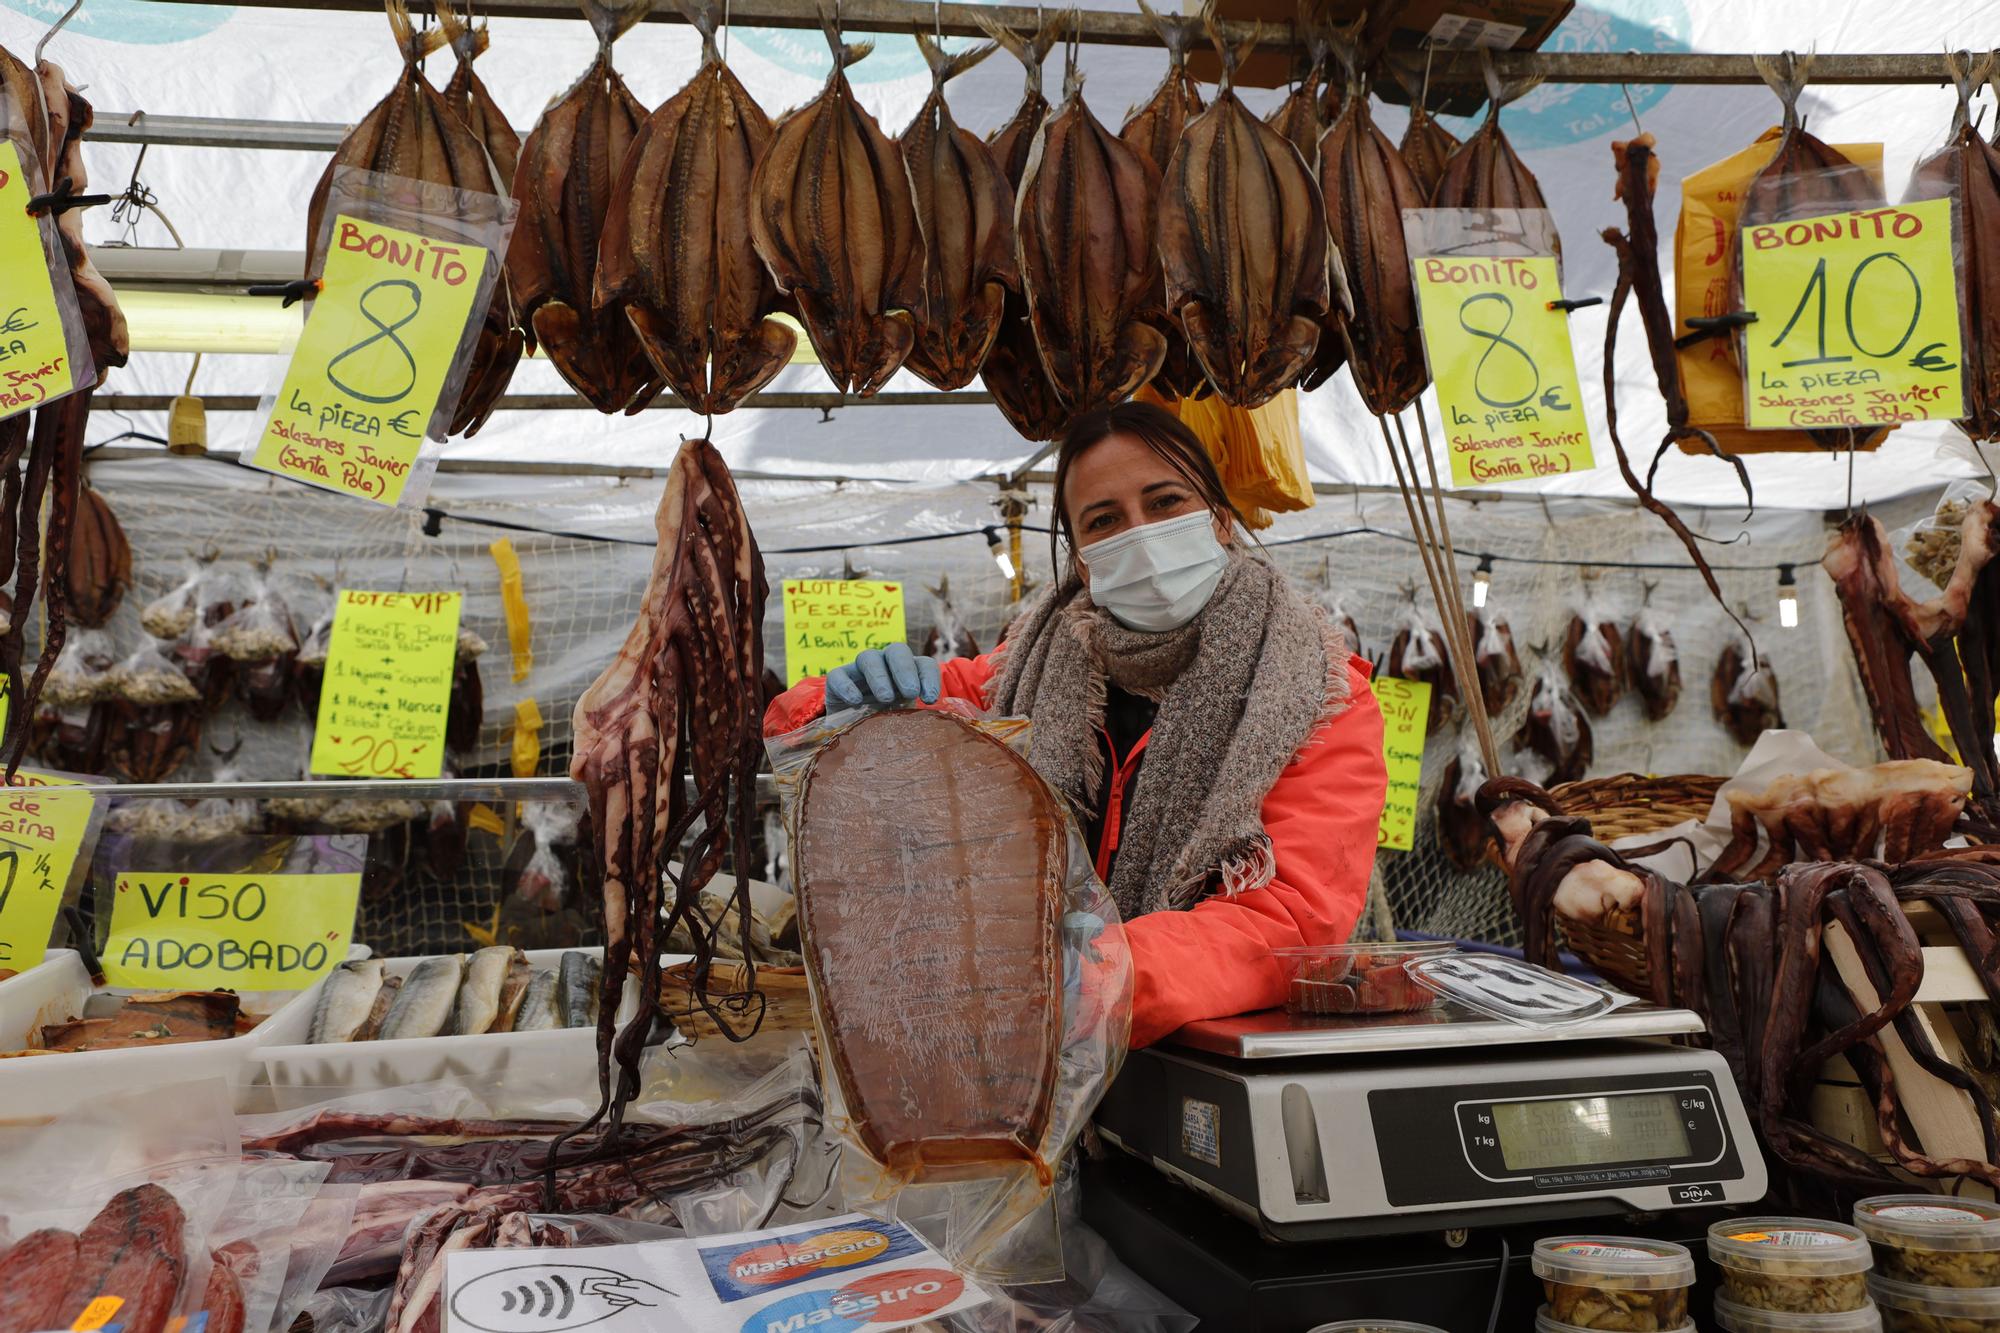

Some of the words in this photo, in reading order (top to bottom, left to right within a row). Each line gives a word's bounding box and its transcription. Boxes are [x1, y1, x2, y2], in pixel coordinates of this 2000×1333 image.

[1752, 209, 1923, 250] BONITO
[339, 223, 468, 286] BONITO
[1770, 252, 1922, 368] 10
[327, 279, 422, 404] 8
[1459, 292, 1539, 408] 8
[1908, 343, 1958, 372] €
[1759, 391, 1855, 408] Salazones
[1864, 385, 1948, 403] Javier
[387, 410, 421, 438] €
[271, 419, 345, 457] Salazones
[355, 445, 410, 477] Javier
[1452, 434, 1524, 453] Salazones
[1530, 431, 1583, 448] Javier
[800, 580, 875, 599] LOTES
[798, 633, 811, 648] 1
[338, 736, 398, 775] 20
[9, 798, 41, 817] de
[0, 818, 55, 841] aina
[1478, 1114, 1490, 1126] kg
[1474, 1136, 1482, 1147] T
[1482, 1136, 1495, 1148] kg
[1680, 1188, 1712, 1199] DINA
[735, 1235, 884, 1280] MasterCard
[767, 1281, 942, 1333] Maestro
